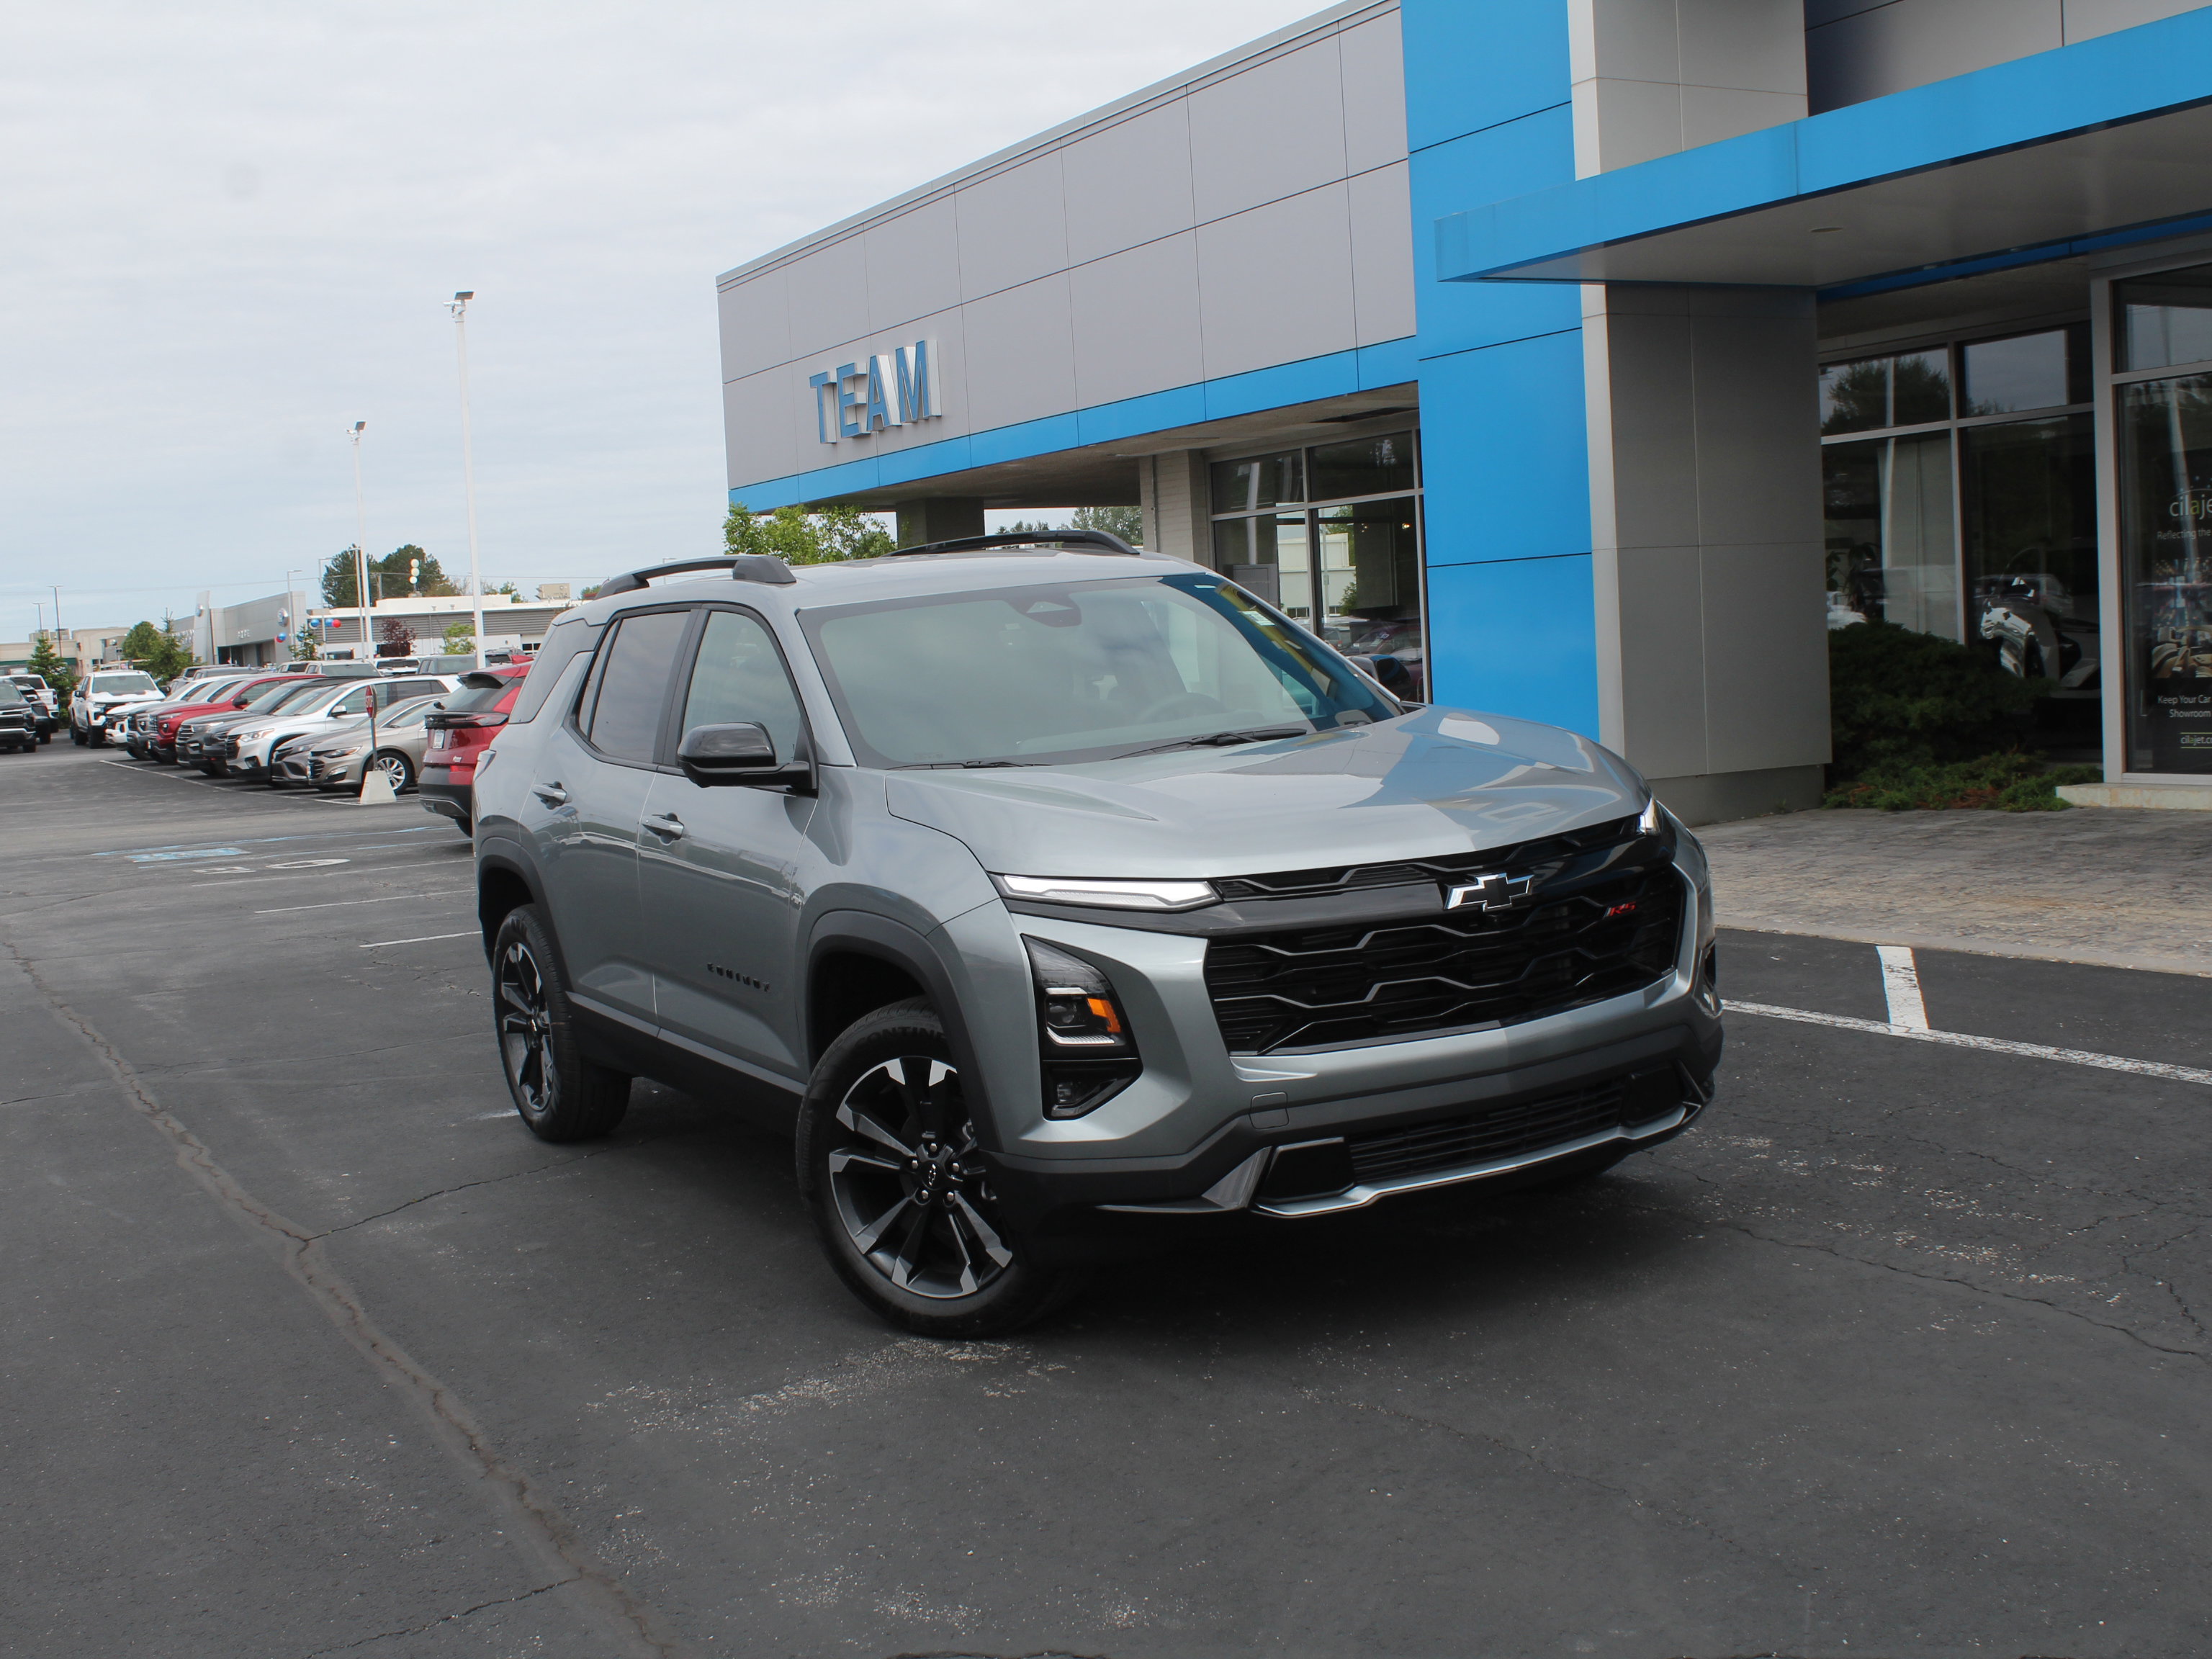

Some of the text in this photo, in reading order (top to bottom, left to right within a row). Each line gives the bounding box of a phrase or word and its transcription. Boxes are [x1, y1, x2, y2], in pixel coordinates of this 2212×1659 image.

[809, 340, 942, 444] TEAM
[2157, 528, 2211, 540] Reflecting the
[2158, 696, 2177, 705] Keep
[2198, 695, 2211, 703] Car
[2170, 709, 2211, 718] Showroom
[1605, 901, 1636, 917] RS
